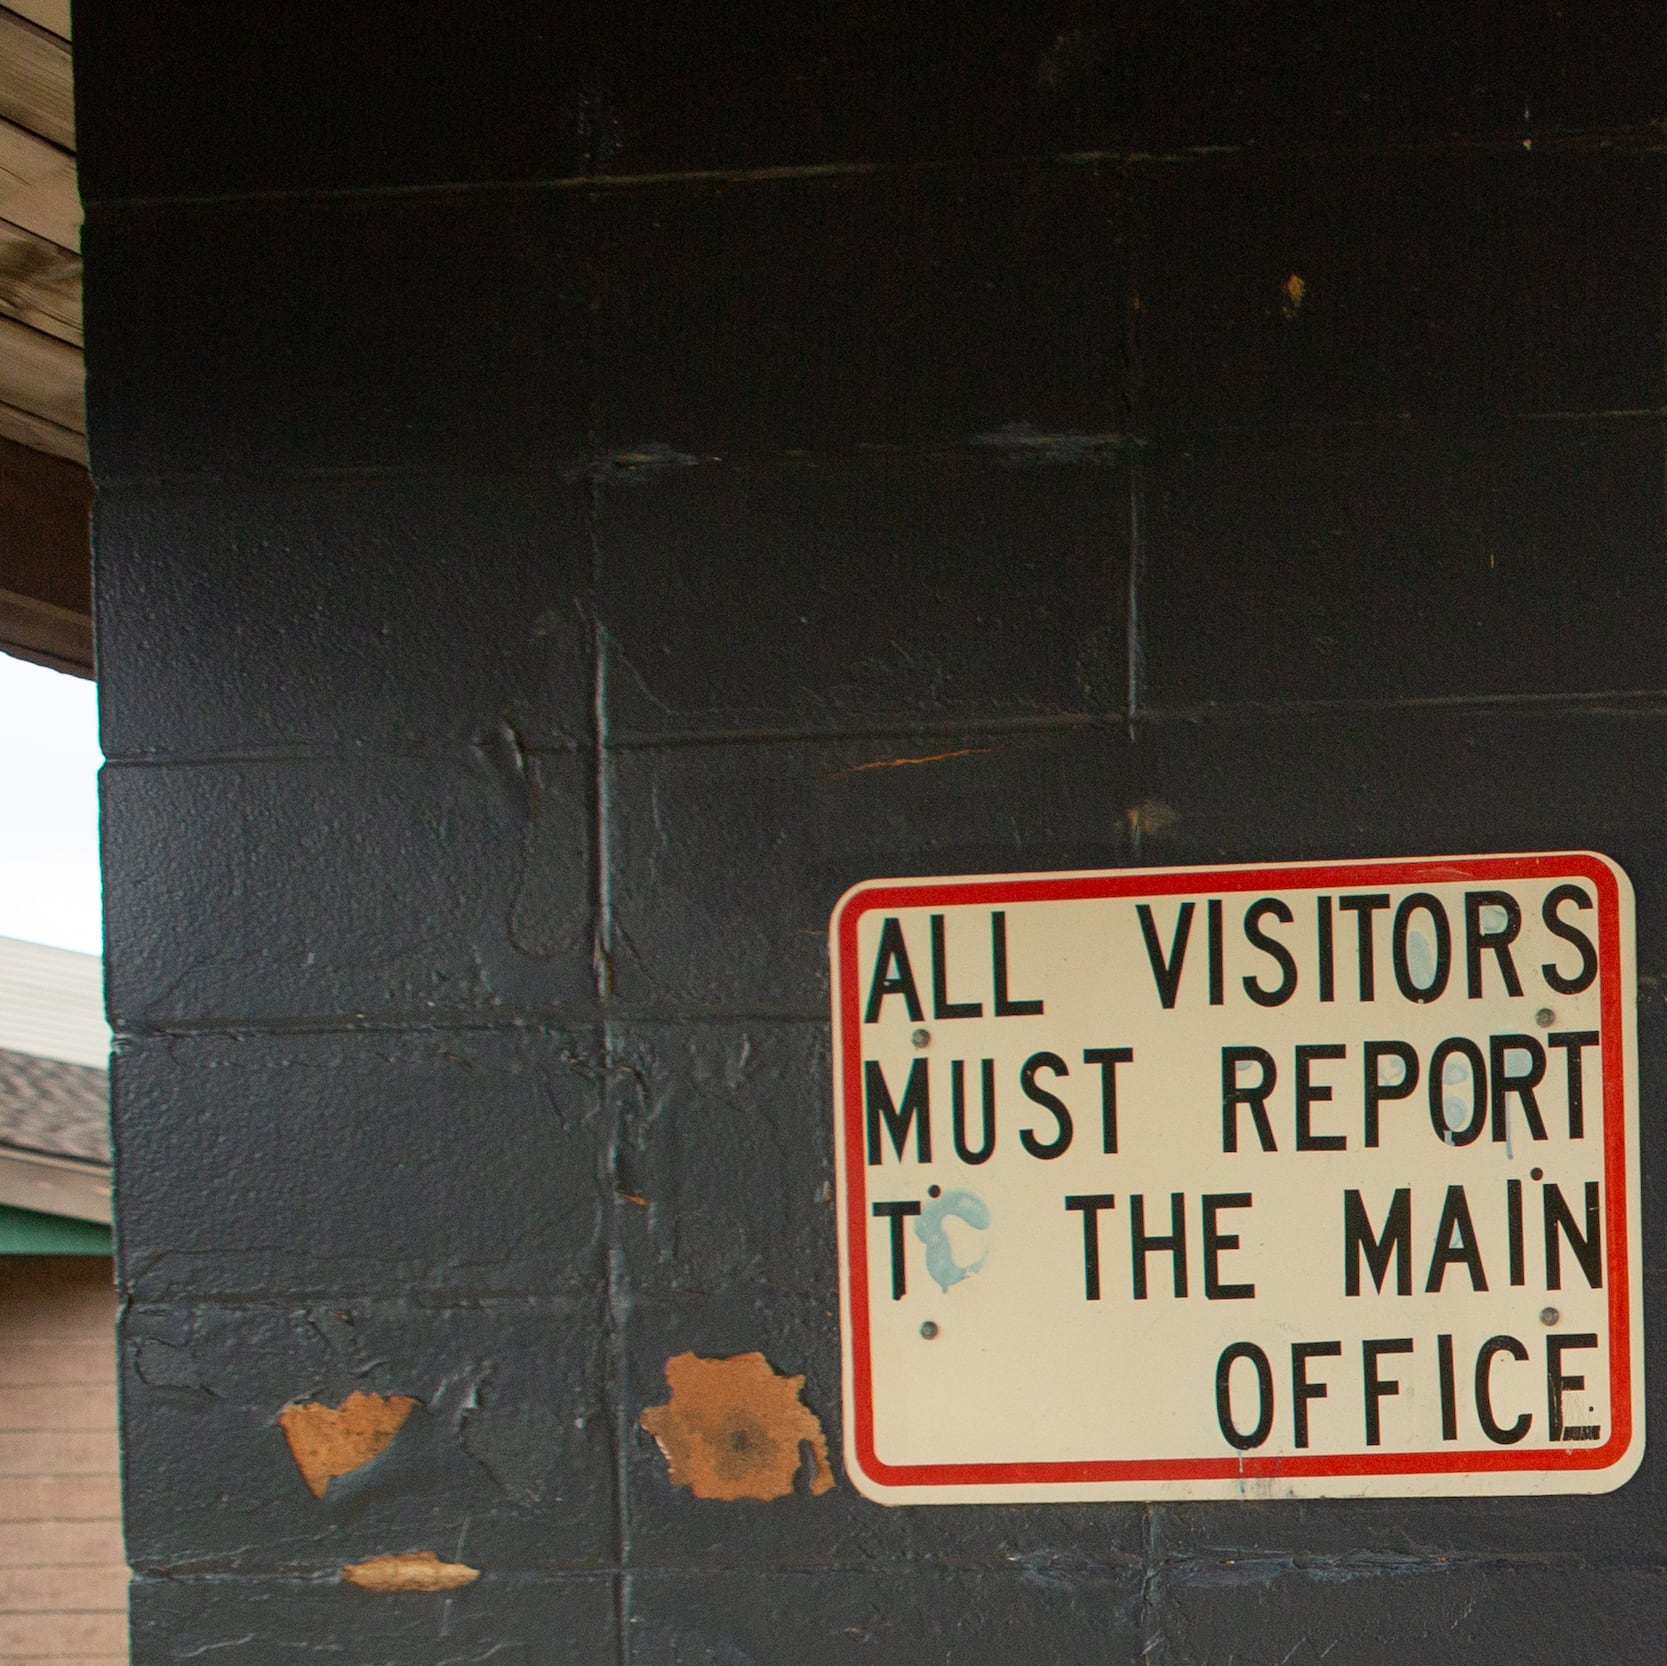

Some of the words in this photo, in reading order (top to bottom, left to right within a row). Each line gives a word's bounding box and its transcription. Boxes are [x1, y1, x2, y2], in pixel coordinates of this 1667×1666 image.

[864, 910, 1046, 1024] ALL
[1136, 884, 1600, 1010] VISITORS
[864, 1046, 1134, 1167] MUST
[1221, 1030, 1600, 1154] REPORT
[1065, 1191, 1257, 1301] THE
[1343, 1179, 1604, 1298] MAIN
[1216, 1333, 1602, 1452] OFFICE
